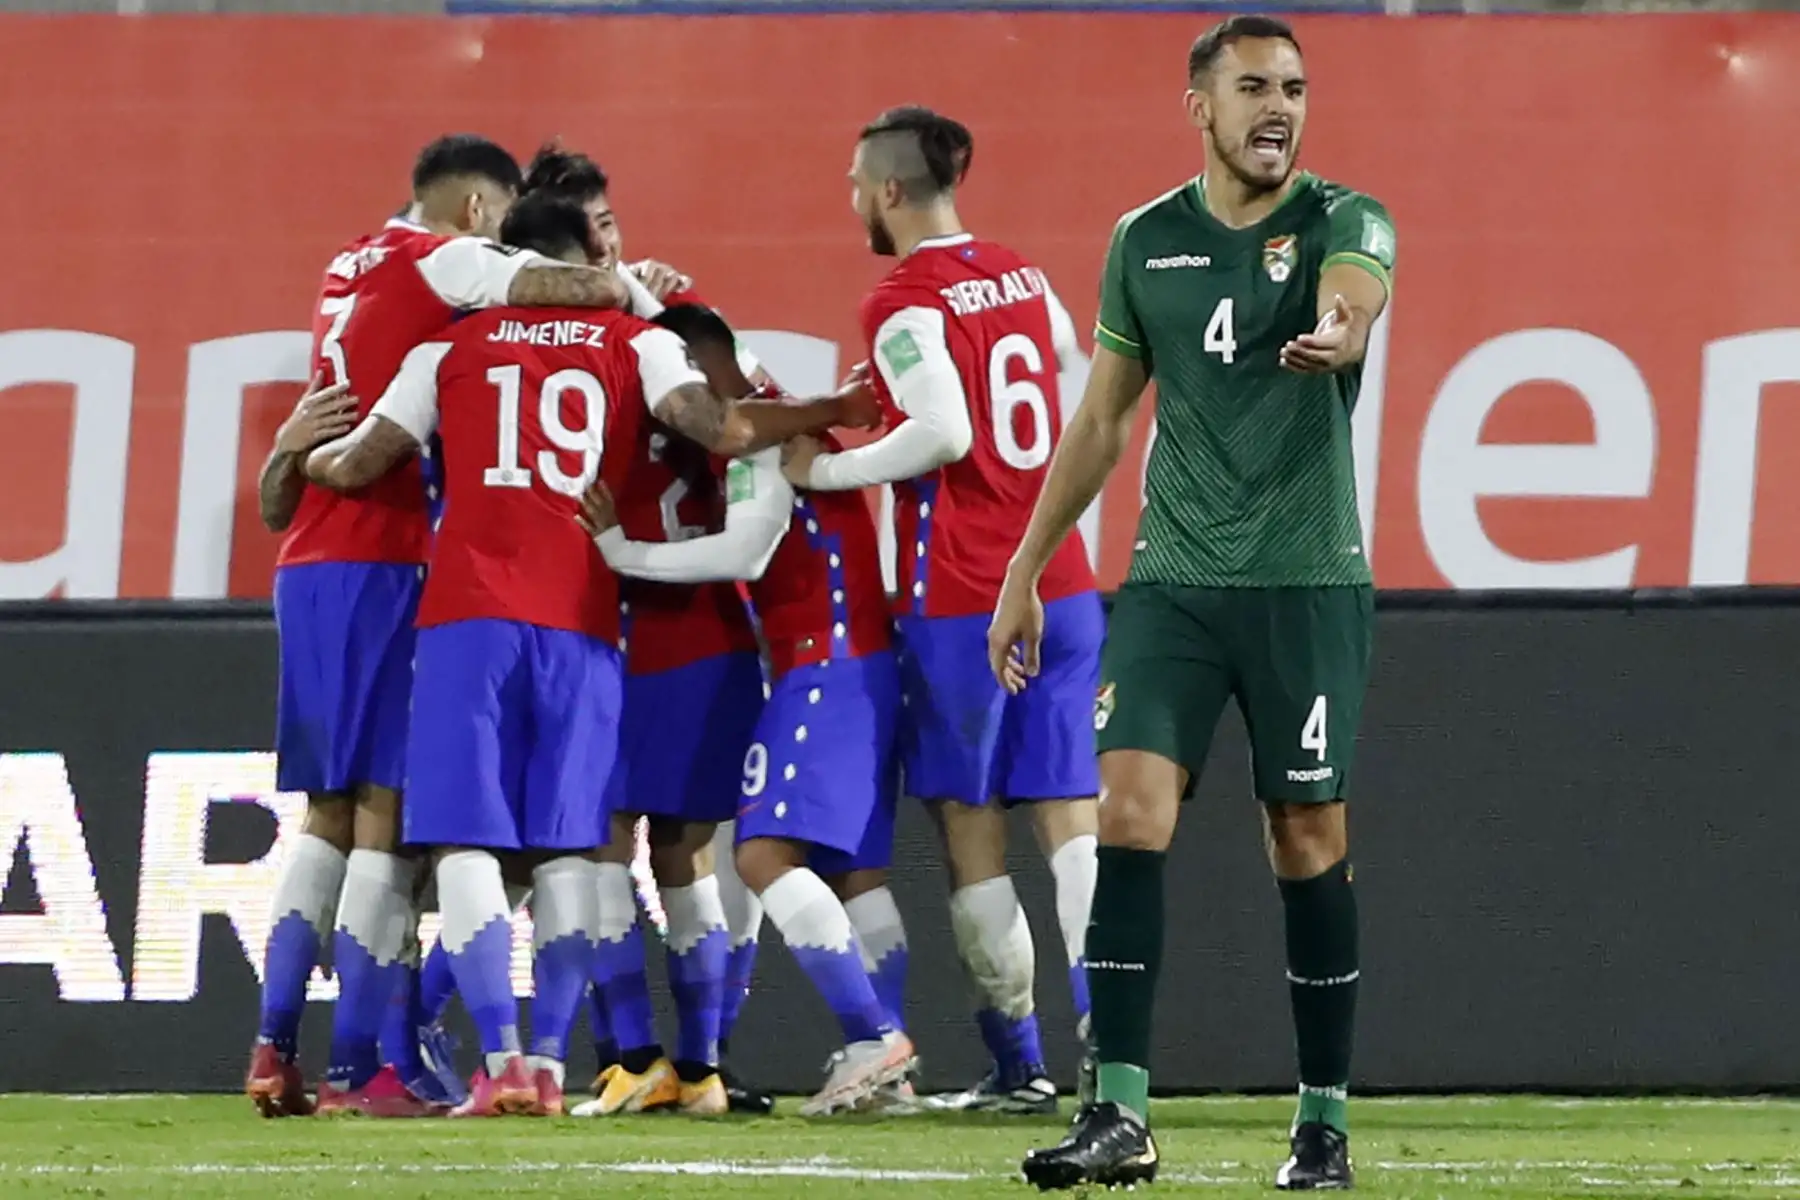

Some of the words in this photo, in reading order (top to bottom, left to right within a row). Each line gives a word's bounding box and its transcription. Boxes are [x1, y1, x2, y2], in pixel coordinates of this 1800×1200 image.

[487, 320, 606, 348] JIMENEZ
[1203, 298, 1237, 364] 4
[484, 364, 606, 499] 19
[989, 333, 1051, 470] 6
[1301, 695, 1327, 761] 4
[741, 742, 768, 796] 9
